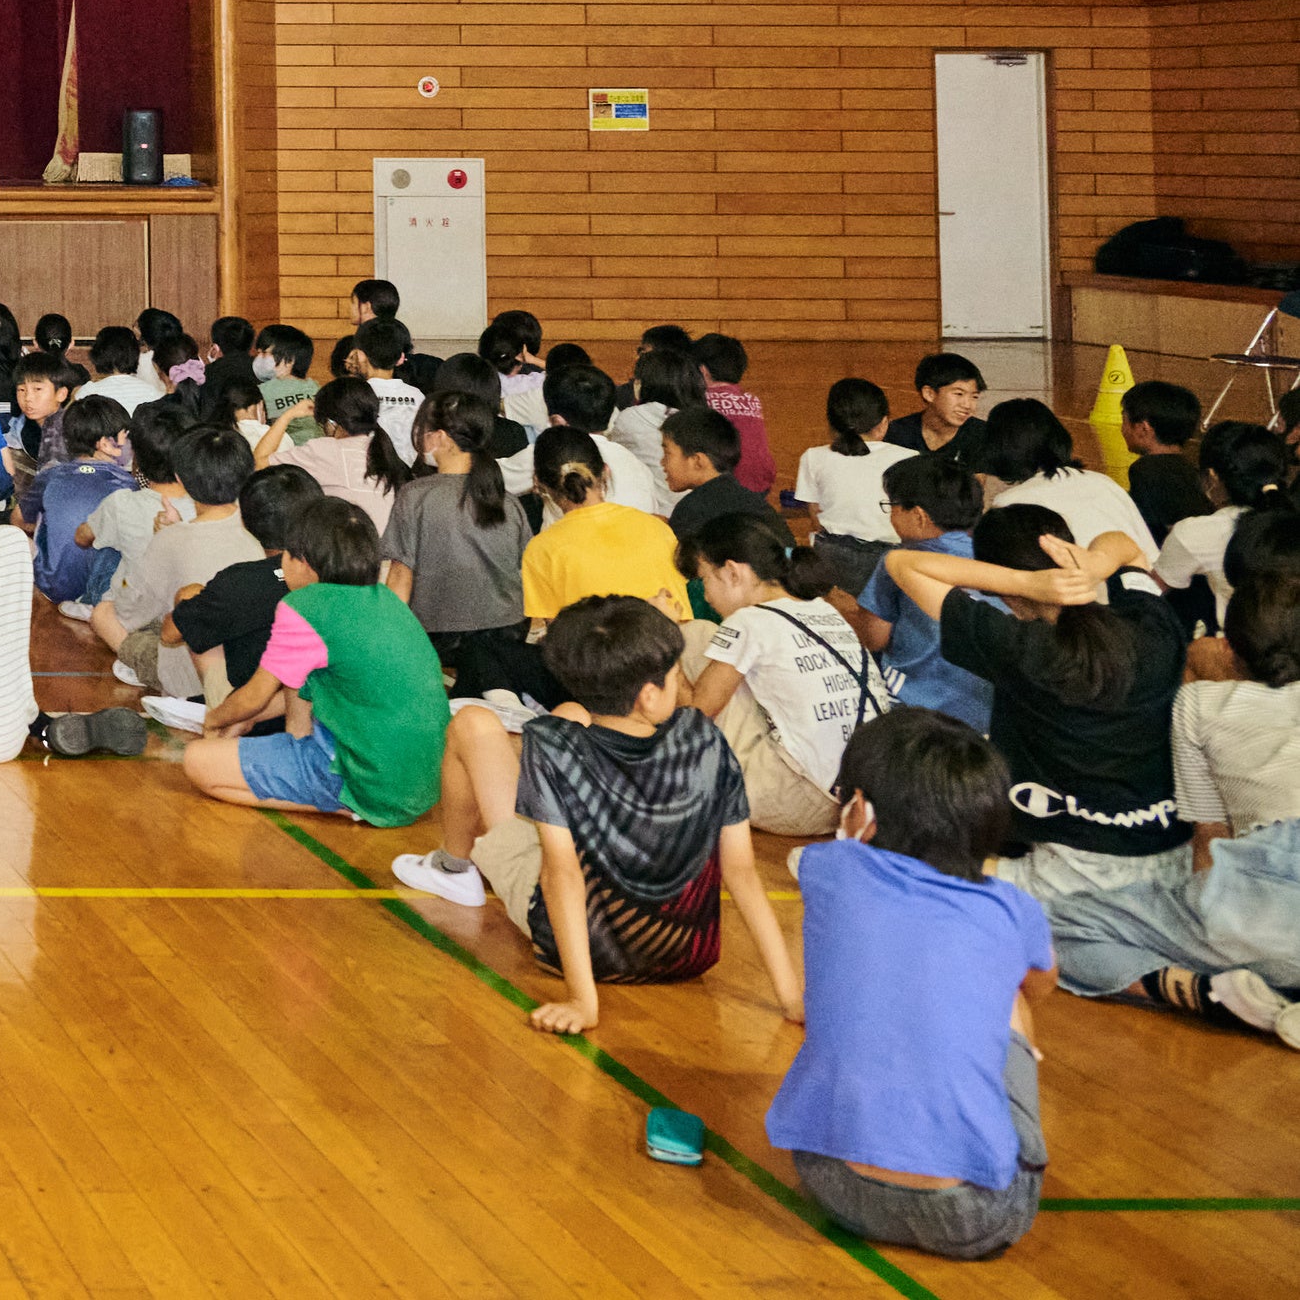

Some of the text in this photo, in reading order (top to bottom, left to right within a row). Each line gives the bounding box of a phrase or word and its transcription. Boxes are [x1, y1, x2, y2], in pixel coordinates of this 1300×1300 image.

[792, 633, 817, 650] LIK
[794, 653, 831, 674] ROCK
[822, 673, 858, 694] HIGHE
[813, 697, 851, 722] LEAVE
[1008, 781, 1176, 829] Champ
